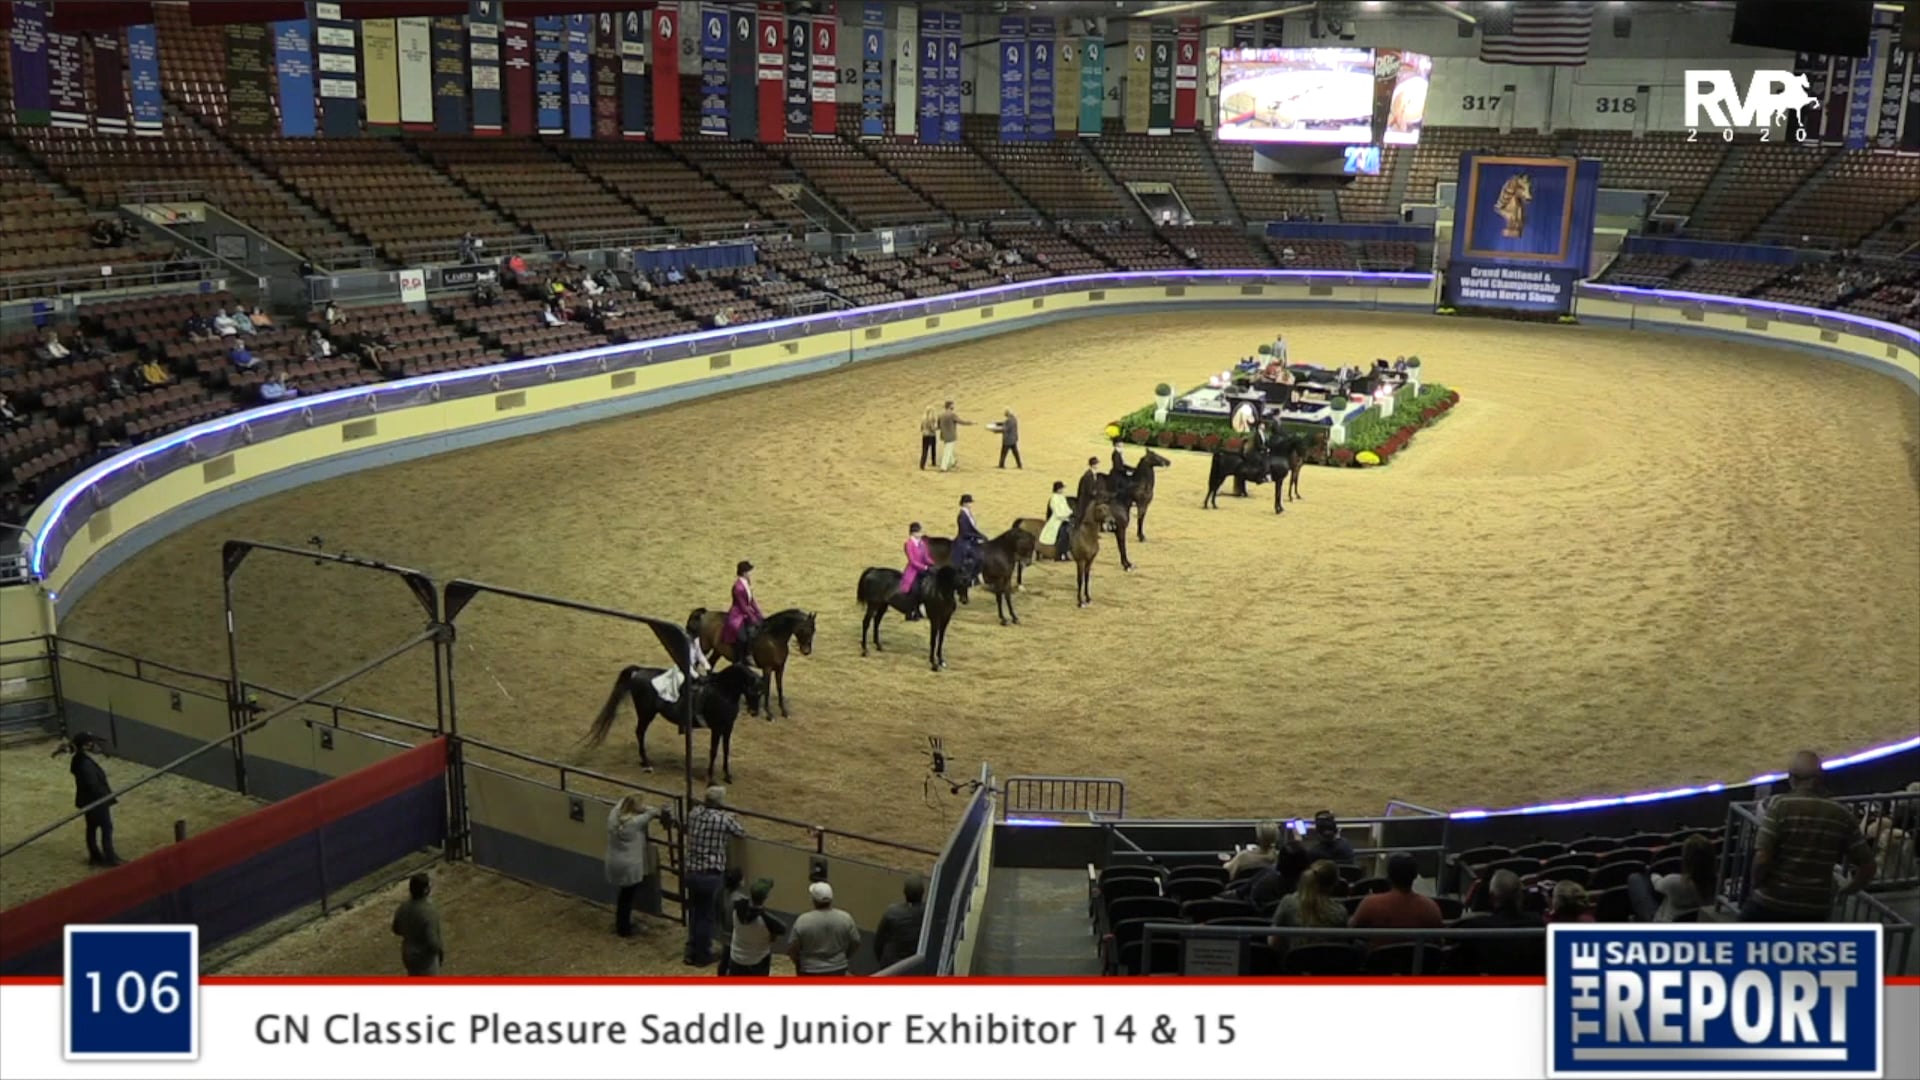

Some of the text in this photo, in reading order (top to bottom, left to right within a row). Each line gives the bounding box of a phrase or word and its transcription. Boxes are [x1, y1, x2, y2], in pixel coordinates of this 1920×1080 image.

[1462, 95, 1502, 111] 317
[1595, 97, 1637, 113] 318
[1471, 267, 1551, 281] Grand National &
[1460, 277, 1561, 293] World Championship
[1461, 287, 1498, 299] Morgan
[1499, 290, 1527, 301] Horse
